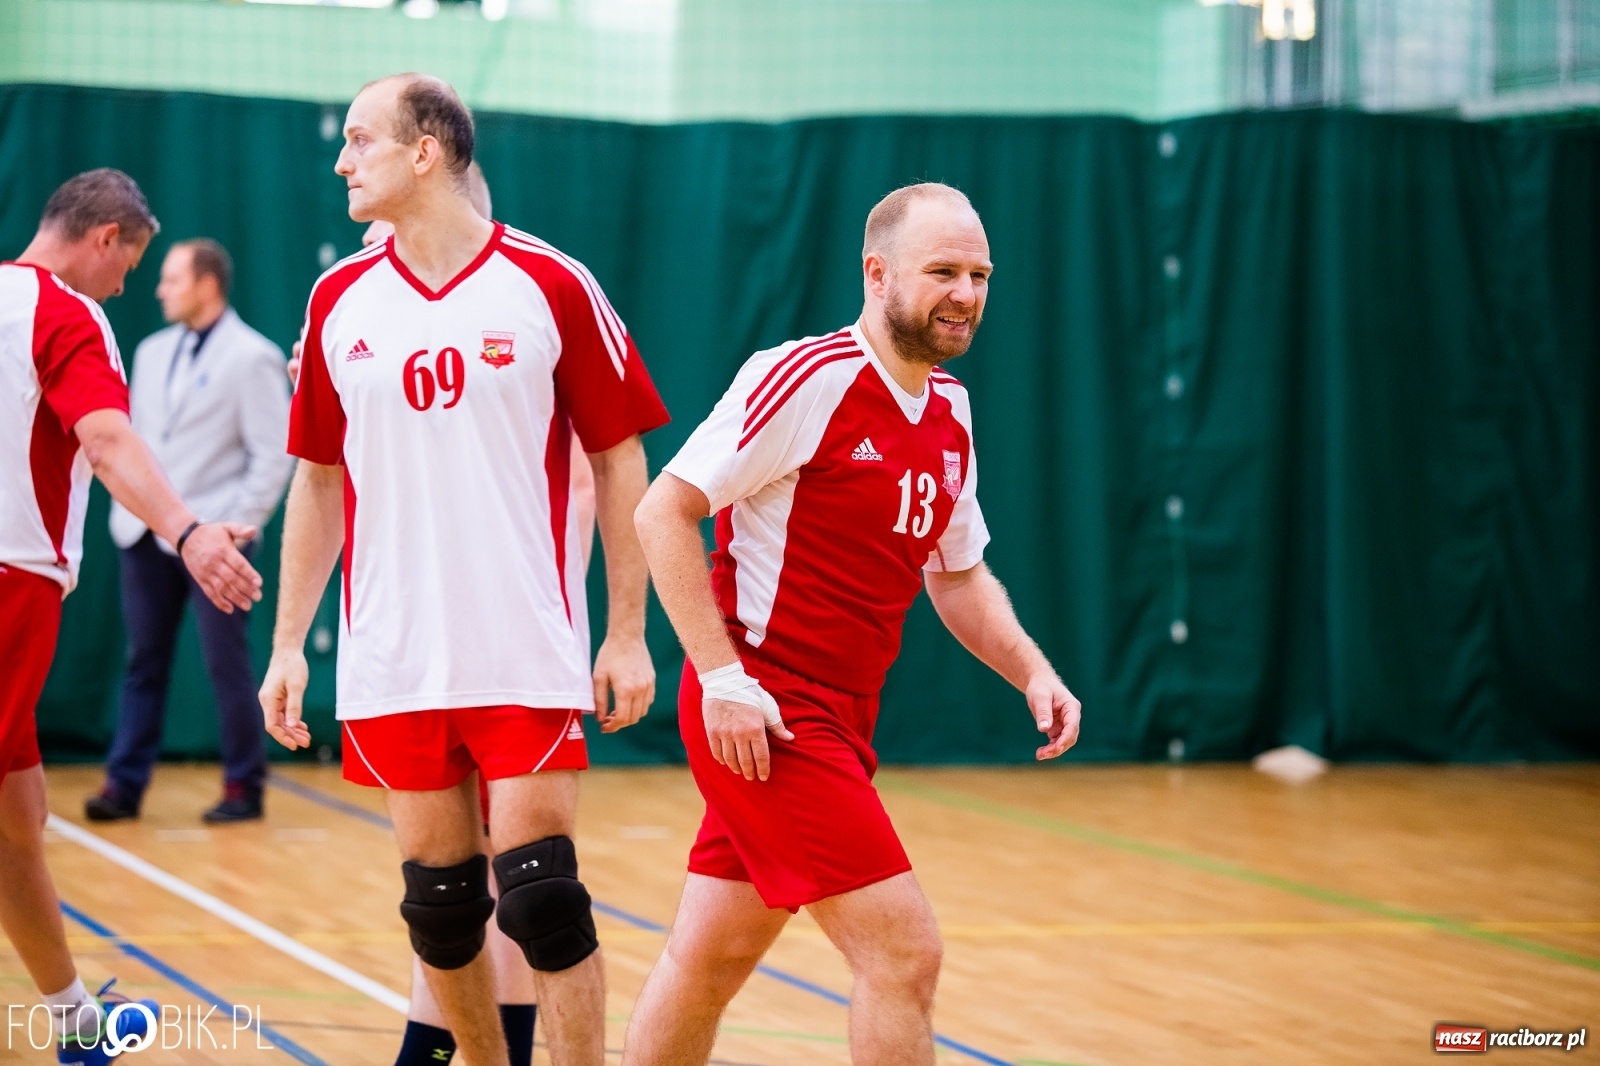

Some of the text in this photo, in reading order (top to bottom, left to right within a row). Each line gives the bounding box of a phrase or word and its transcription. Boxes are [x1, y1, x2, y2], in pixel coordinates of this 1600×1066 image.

[402, 346, 465, 412] 69
[851, 452, 883, 462] adidas
[892, 468, 937, 539] 13
